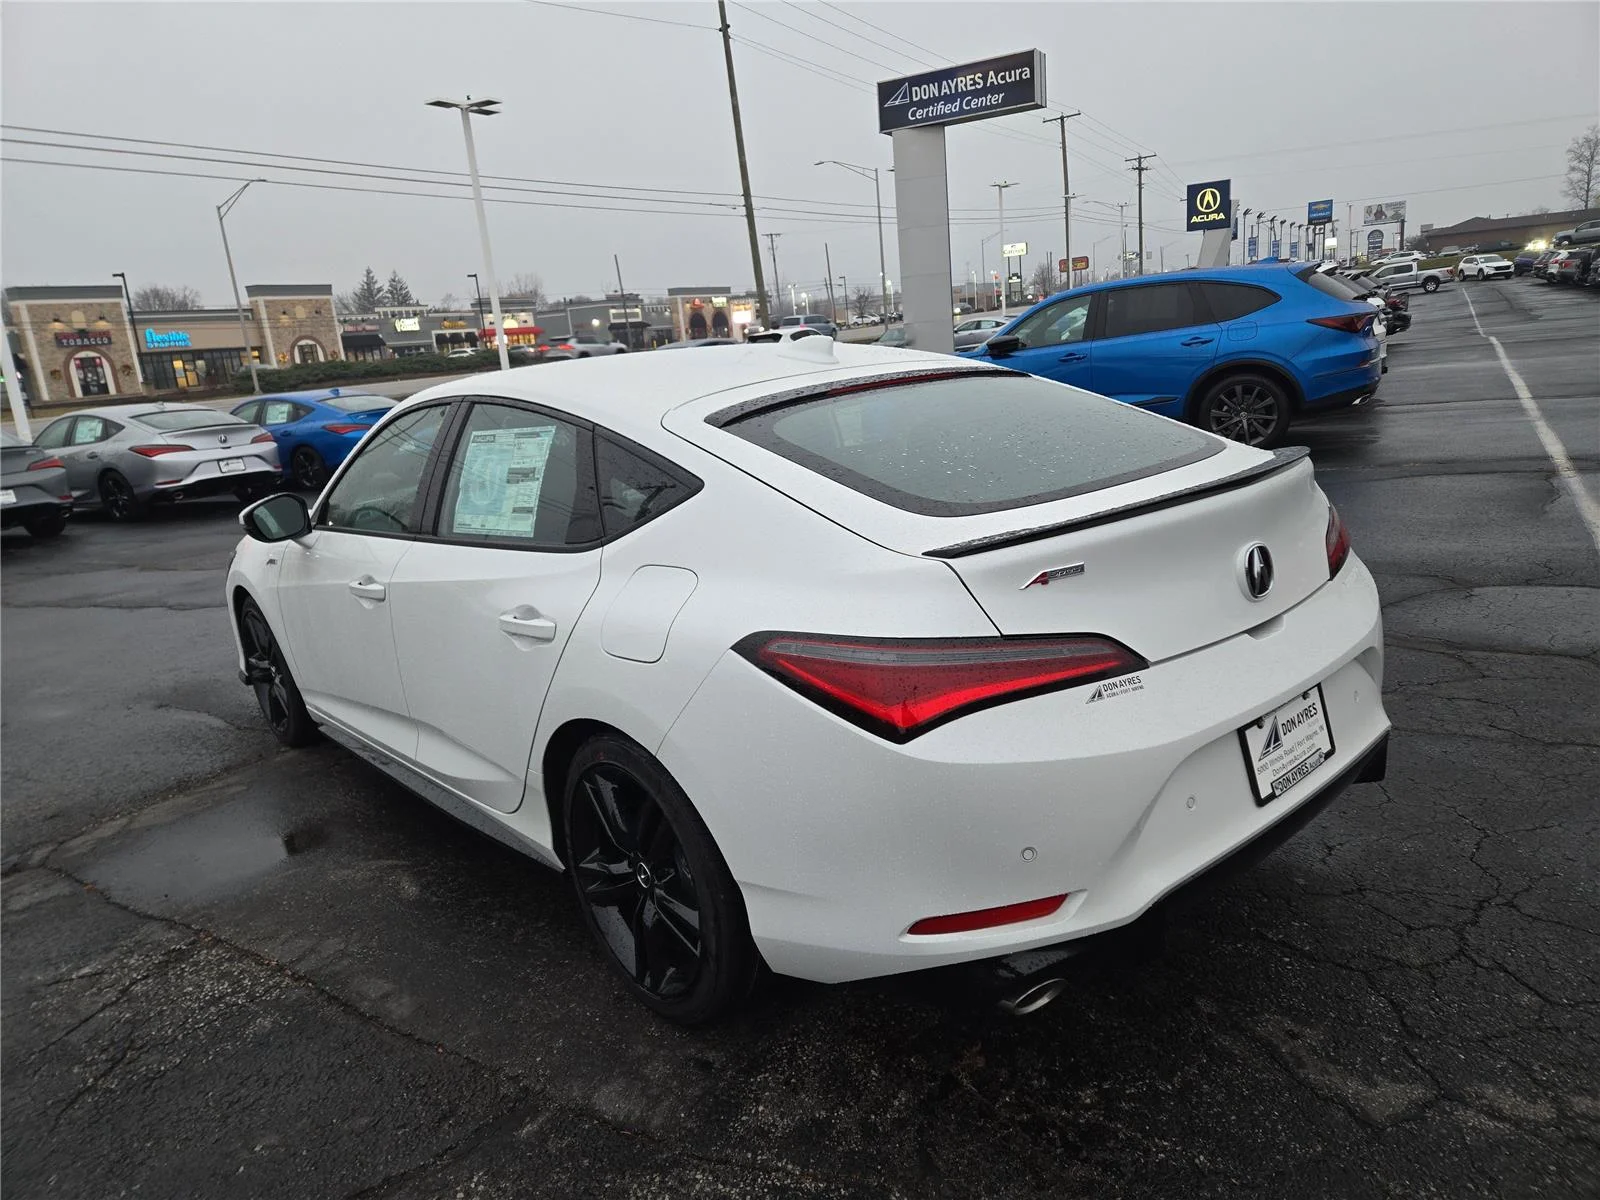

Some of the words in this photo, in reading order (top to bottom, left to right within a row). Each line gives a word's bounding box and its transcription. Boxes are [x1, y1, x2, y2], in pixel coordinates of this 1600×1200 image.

[911, 82, 940, 102] DON
[941, 72, 983, 96] AYRES
[986, 65, 1031, 87] Acura
[908, 97, 960, 121] Certified
[962, 91, 1004, 110] Center
[1190, 212, 1226, 224] ACURA
[62, 336, 109, 346] TOBACCO
[1102, 681, 1119, 692] DON
[1119, 675, 1142, 689] AYRES
[1281, 715, 1297, 736] DON
[1296, 702, 1318, 727] AYRES
[1291, 762, 1310, 783] AYRES
